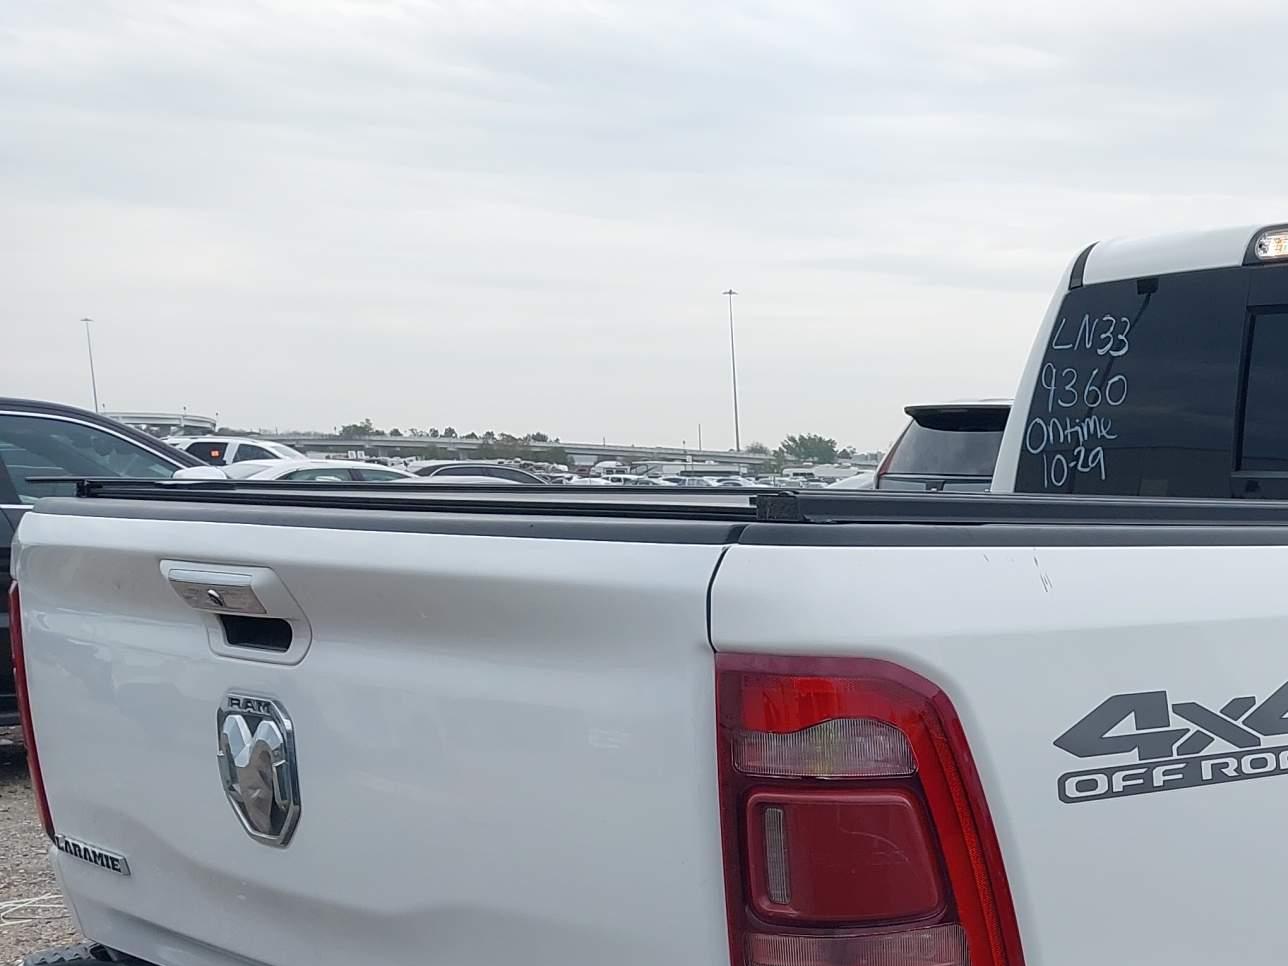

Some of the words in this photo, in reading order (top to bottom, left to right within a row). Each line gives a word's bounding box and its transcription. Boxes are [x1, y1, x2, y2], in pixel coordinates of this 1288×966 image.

[1052, 314, 1131, 357] LN33
[1041, 362, 1127, 413] 9360
[1043, 446, 1106, 488] 10-29
[228, 697, 271, 714] RAM
[1064, 763, 1187, 799] OFF
[55, 835, 122, 873] LARAMIE
